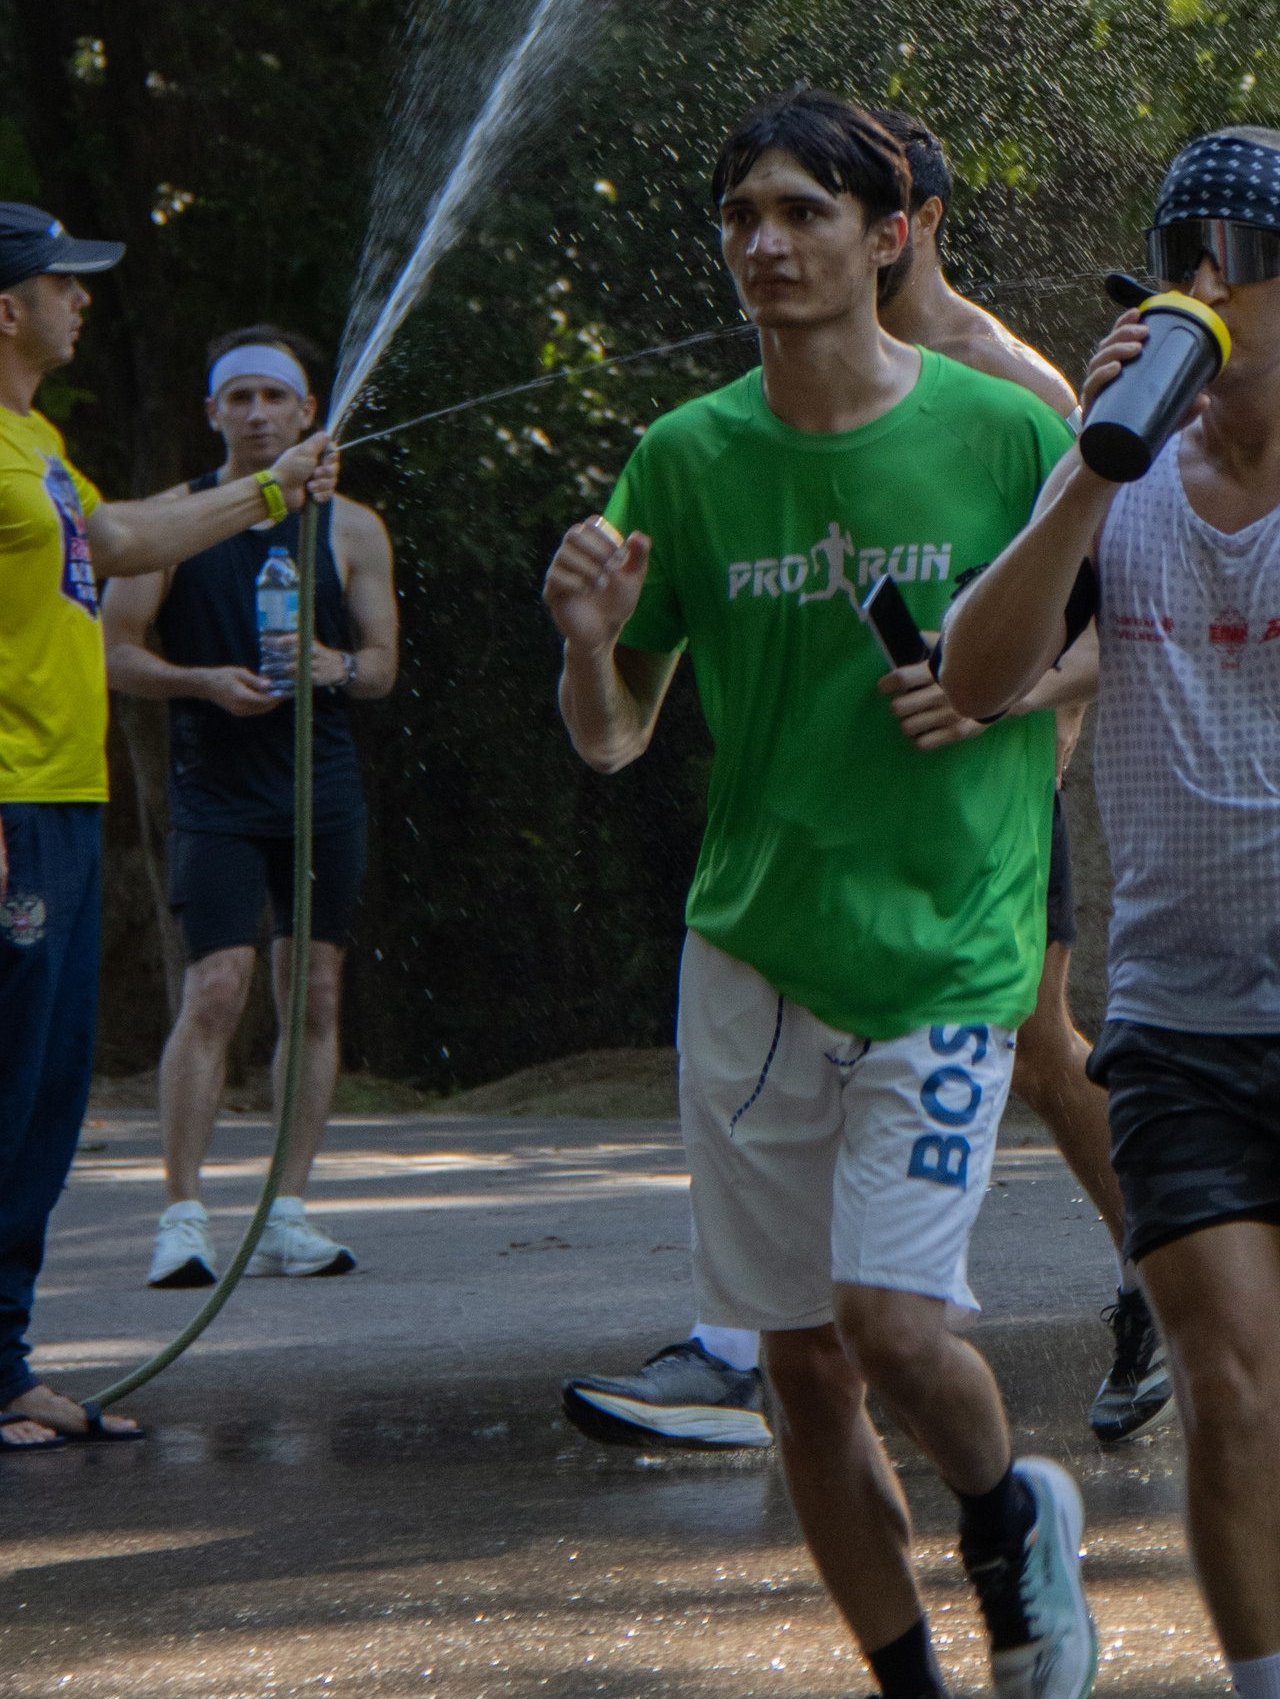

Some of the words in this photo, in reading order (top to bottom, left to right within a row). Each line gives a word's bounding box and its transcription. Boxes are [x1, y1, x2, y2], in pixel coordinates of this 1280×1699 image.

[728, 554, 809, 600] PRO
[857, 543, 952, 587] RUN
[907, 1024, 989, 1193] BOS
